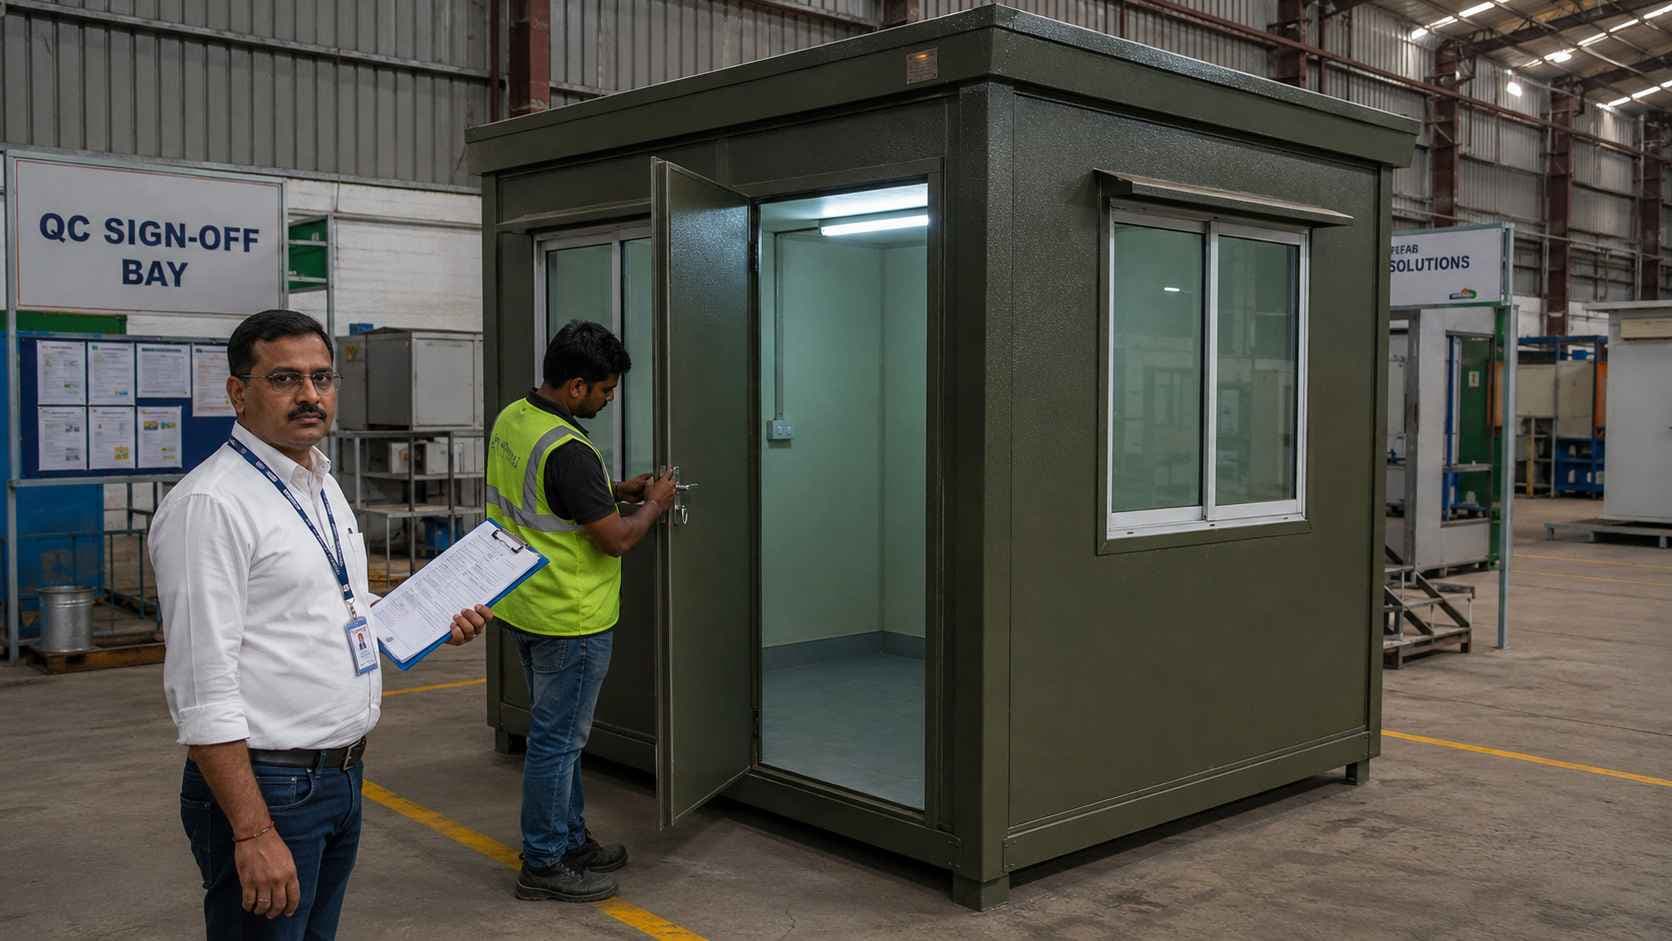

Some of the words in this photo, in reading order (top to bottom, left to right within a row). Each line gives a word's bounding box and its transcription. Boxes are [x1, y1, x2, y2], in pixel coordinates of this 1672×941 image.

[39, 212, 90, 243] QC
[104, 217, 260, 252] SIGN-OFF
[122, 258, 188, 288] BAY
[1390, 255, 1470, 273] SOLUTIONS
